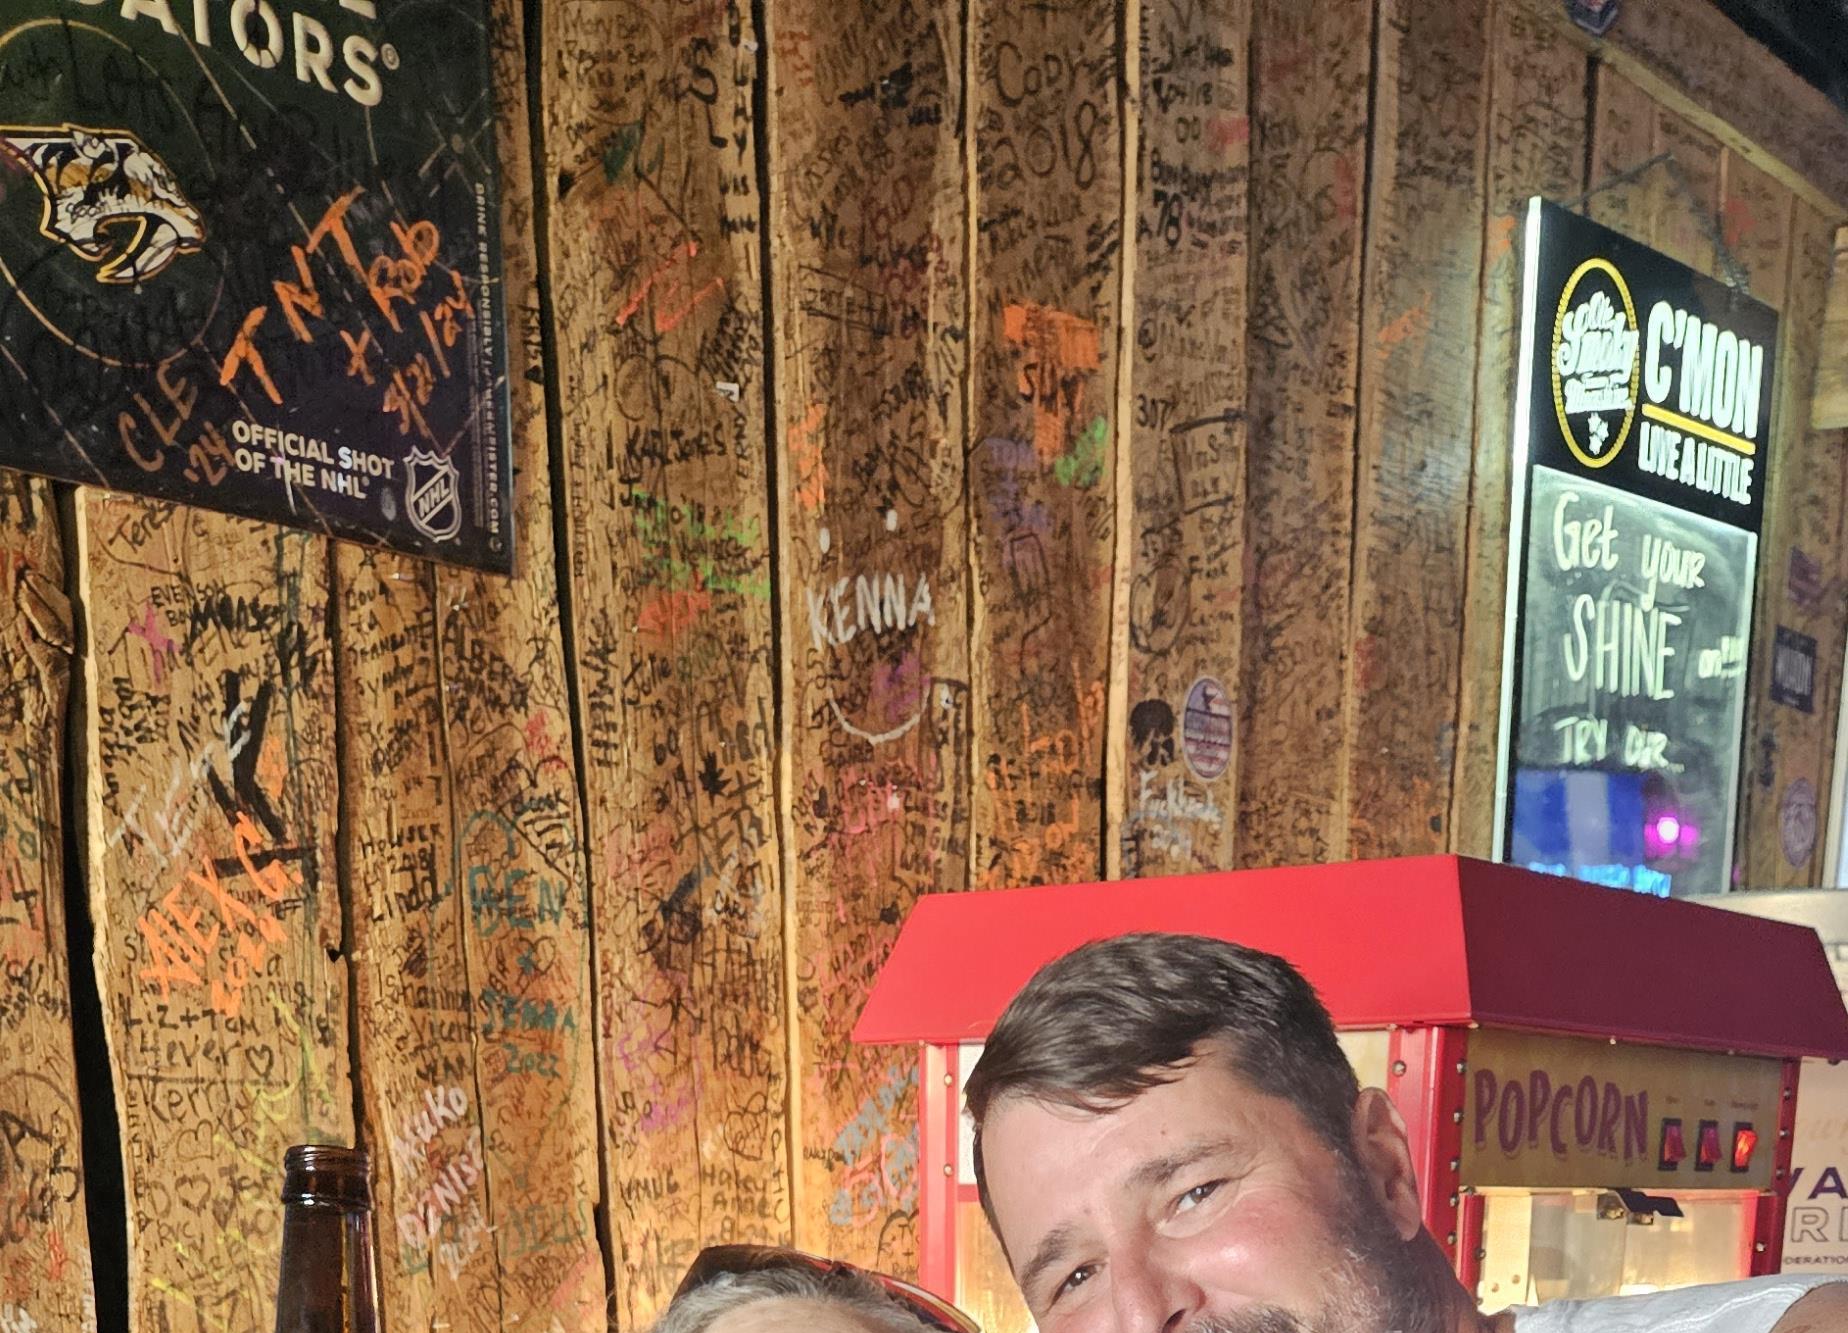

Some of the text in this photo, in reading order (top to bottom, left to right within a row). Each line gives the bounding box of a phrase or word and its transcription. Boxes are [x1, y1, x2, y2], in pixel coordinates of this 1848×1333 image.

[1644, 301, 1764, 439] C'MON
[232, 420, 395, 480] OFFICIAL SHOT
[235, 448, 266, 474] OF
[270, 456, 316, 487] THE
[1638, 421, 1755, 506] LIVE A LITTLE
[418, 480, 451, 519] NHL
[1553, 491, 1620, 572] Get
[806, 572, 934, 650] KENNA
[1563, 593, 1683, 701] SHINE
[1554, 716, 1609, 766] TRY
[1473, 1067, 1651, 1164] POPCORN
